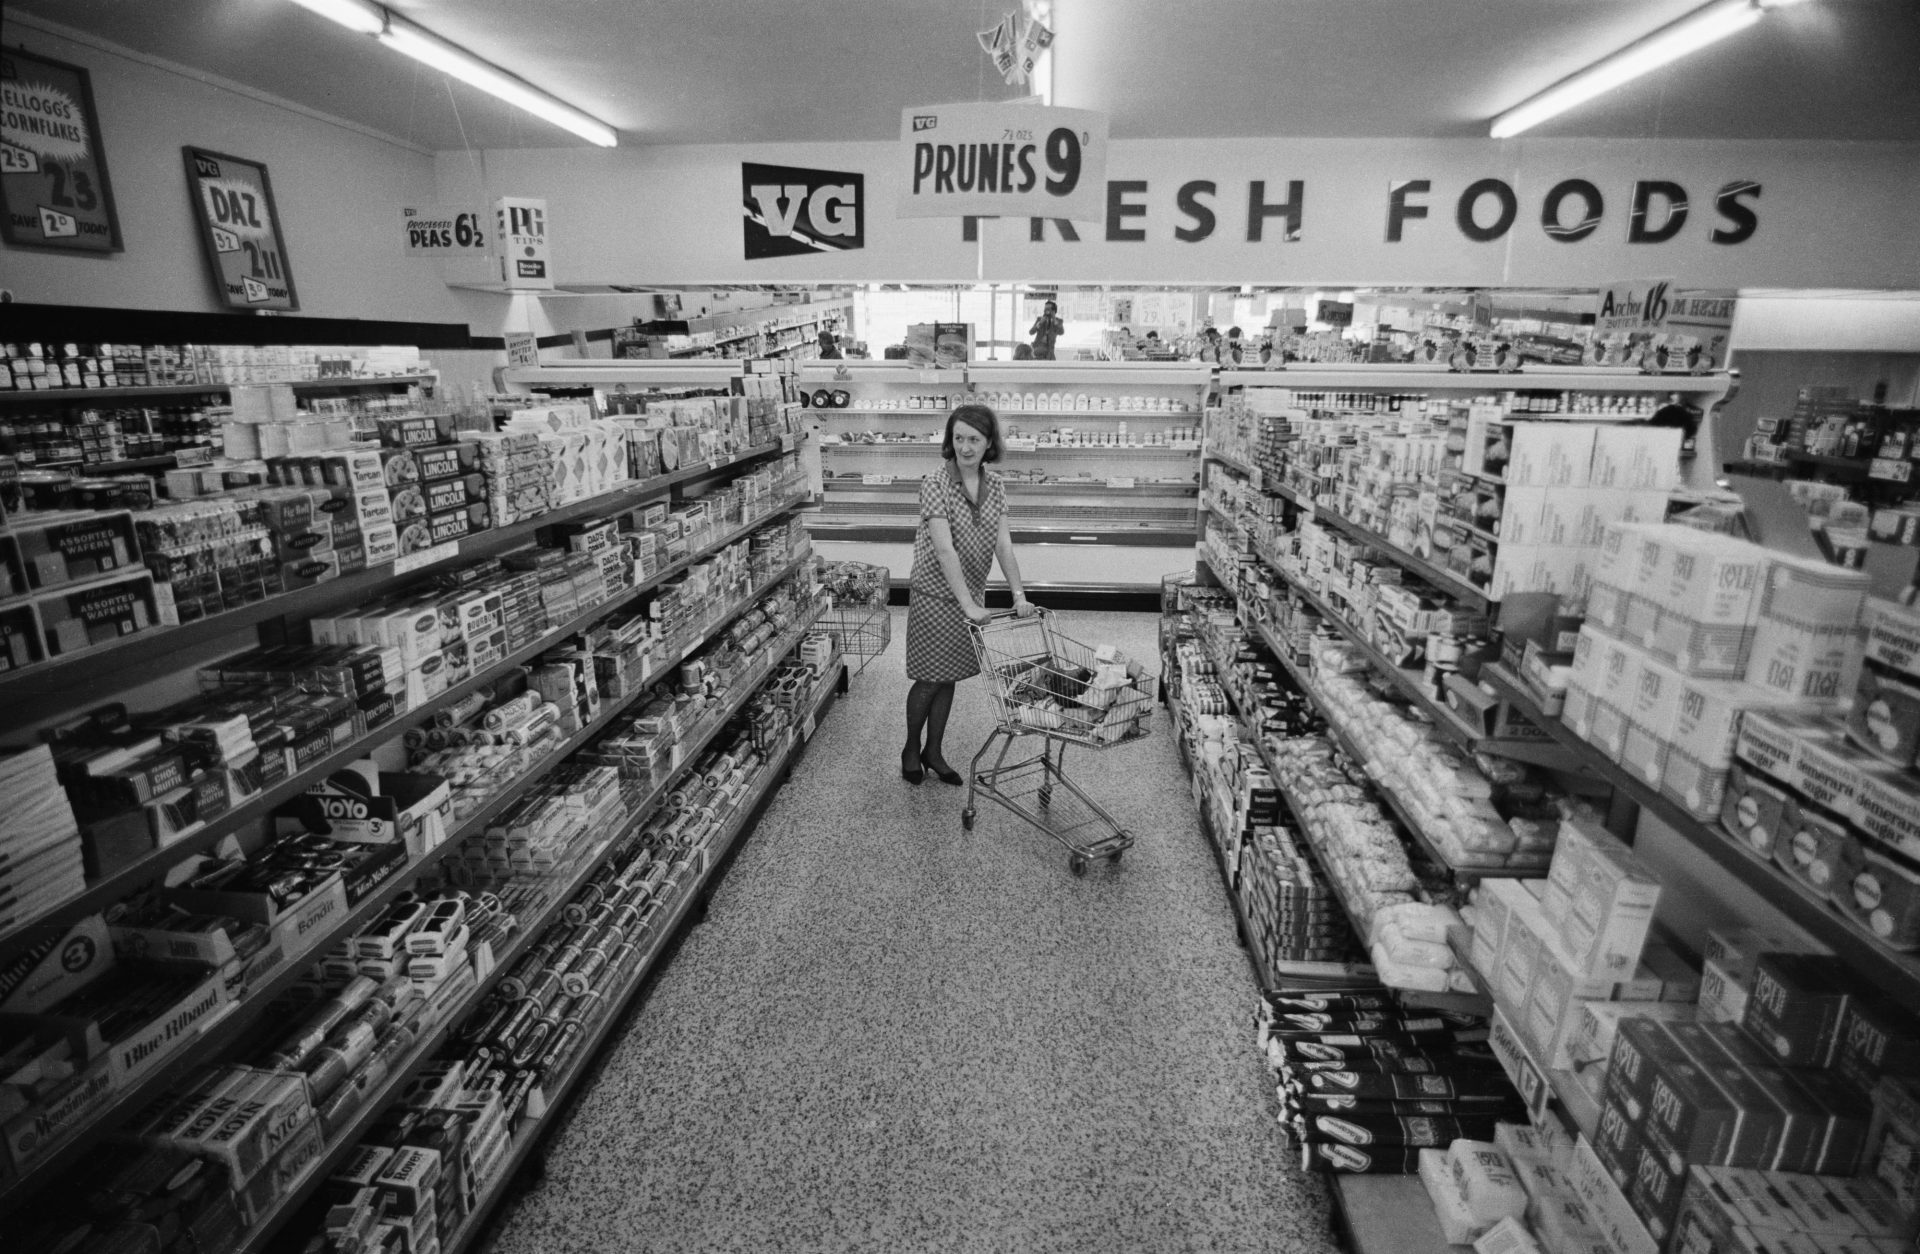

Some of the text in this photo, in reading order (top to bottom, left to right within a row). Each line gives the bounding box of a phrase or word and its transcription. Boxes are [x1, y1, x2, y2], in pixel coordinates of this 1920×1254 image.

[1, 89, 71, 119] ELLOGG'S
[914, 117, 936, 129] VG
[196, 160, 218, 175] VG
[913, 142, 1036, 194] PRUNES
[209, 186, 261, 228] DAZ
[750, 184, 857, 237] VG
[1383, 178, 1761, 244] FOODS
[11, 214, 38, 227] SAVE
[79, 221, 108, 235] TODAY
[508, 206, 544, 237] PG
[410, 230, 452, 247] PEAS
[513, 237, 543, 245] TIPS
[519, 262, 542, 270] Brooke
[268, 288, 287, 298] TODAY
[1600, 289, 1642, 318] Anchor
[1605, 317, 1638, 328] BUTTER
[403, 429, 437, 443] LINCOLN
[353, 471, 381, 481] Tartan
[424, 459, 458, 477] LINCOLN
[430, 491, 465, 509] LINCOLN
[361, 506, 389, 518] Tartan
[60, 529, 115, 547] ASSORTED
[433, 520, 468, 539] LINCOLN
[587, 531, 605, 544] DAD'S
[67, 540, 110, 554] WAFERS
[369, 542, 395, 554] Tartan
[602, 552, 618, 566] DAD'S
[606, 574, 622, 587] DAD'S
[81, 593, 135, 613] ASSORTED
[87, 604, 130, 620] WAFERS
[467, 613, 496, 631] BOURBON
[366, 700, 392, 721] memo
[297, 735, 329, 759] memo
[1741, 729, 1790, 763] demerara
[154, 766, 177, 783] CHOC
[1797, 759, 1854, 796] demerara
[201, 783, 220, 797] CHOC
[1802, 776, 1836, 804] sugar
[1864, 815, 1905, 844] sugar
[297, 899, 335, 936] Bandit
[124, 988, 219, 1069] Blue Riband
[183, 1098, 238, 1138] NICE
[213, 1102, 265, 1141] NICE
[267, 1103, 307, 1148] NIC
[346, 1148, 377, 1176] Rover
[394, 1149, 424, 1180] Rover
